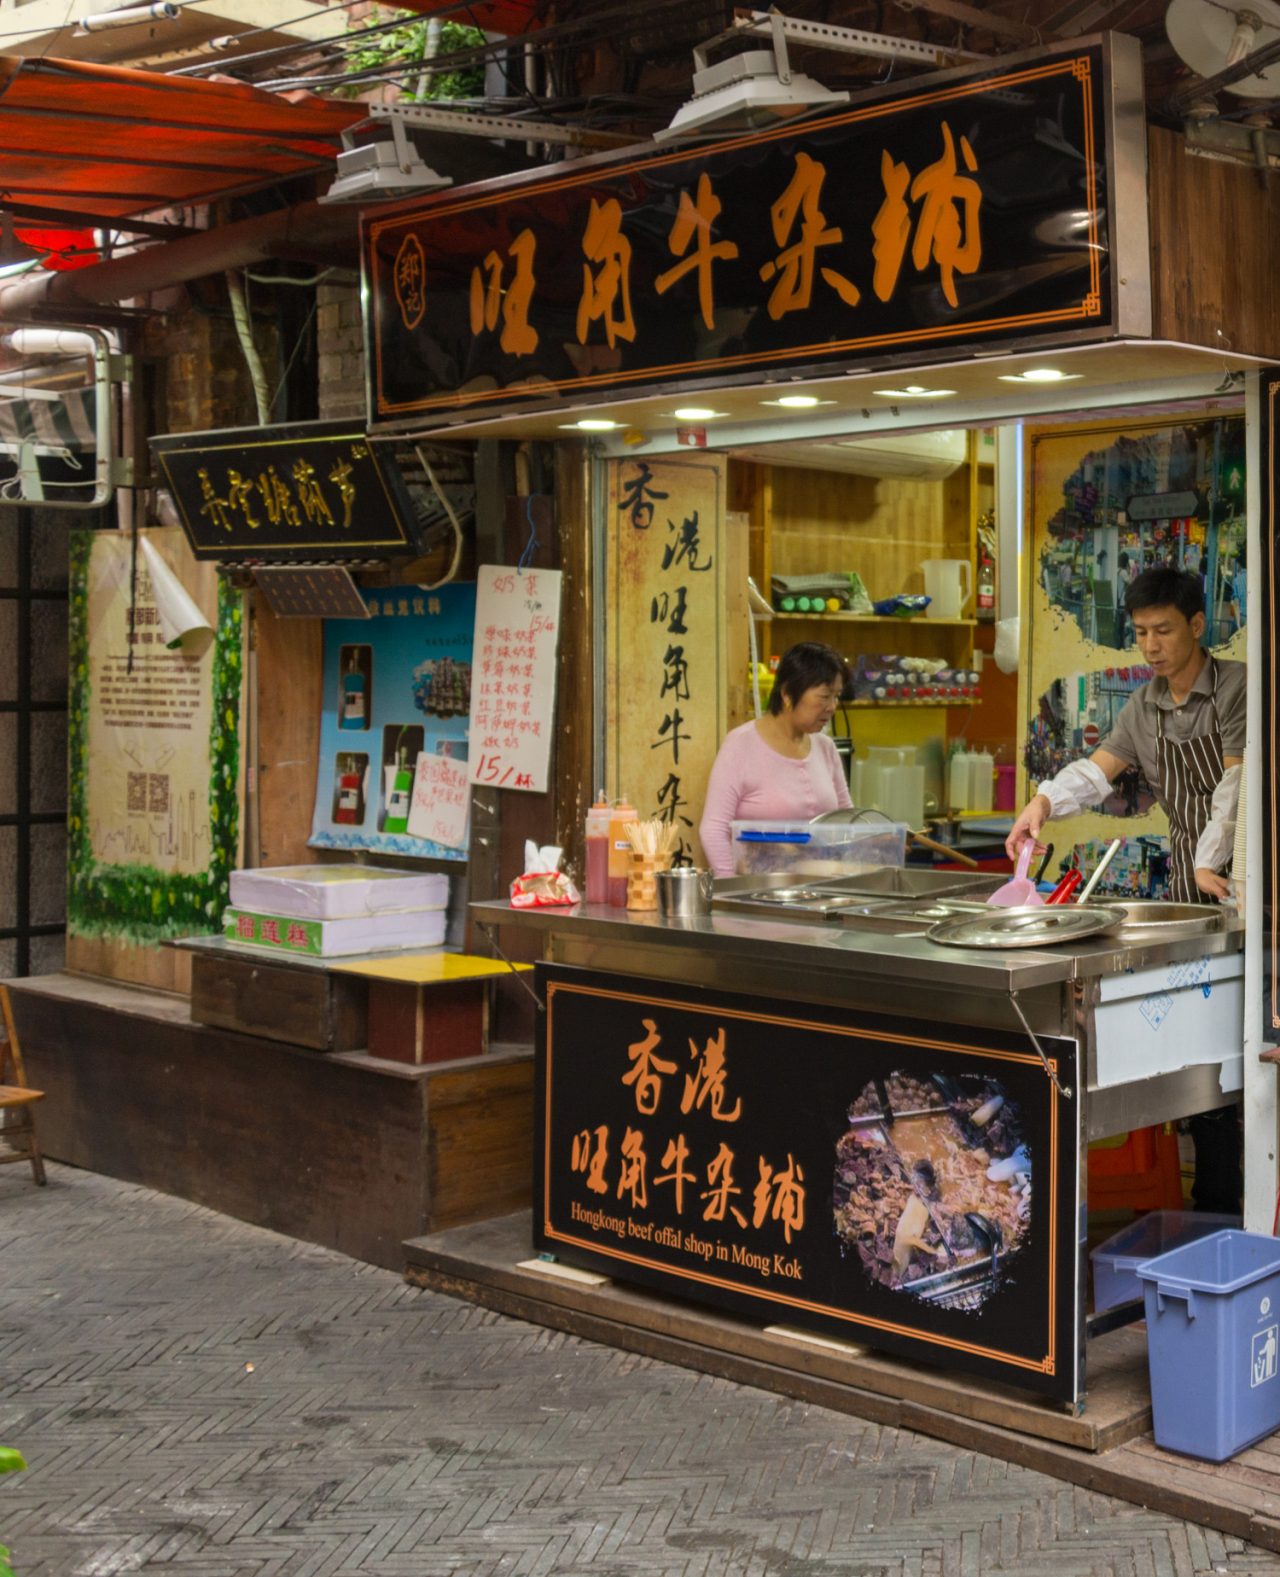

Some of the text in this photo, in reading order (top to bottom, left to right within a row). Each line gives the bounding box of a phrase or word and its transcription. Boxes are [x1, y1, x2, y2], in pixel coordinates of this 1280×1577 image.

[470, 120, 982, 358] 旺角牛杂铺
[621, 1019, 742, 1123] 香港
[571, 1124, 806, 1244] 旺角牛杂铺
[571, 1201, 803, 1280] Hongkong beef offal shop in Mong Kok
